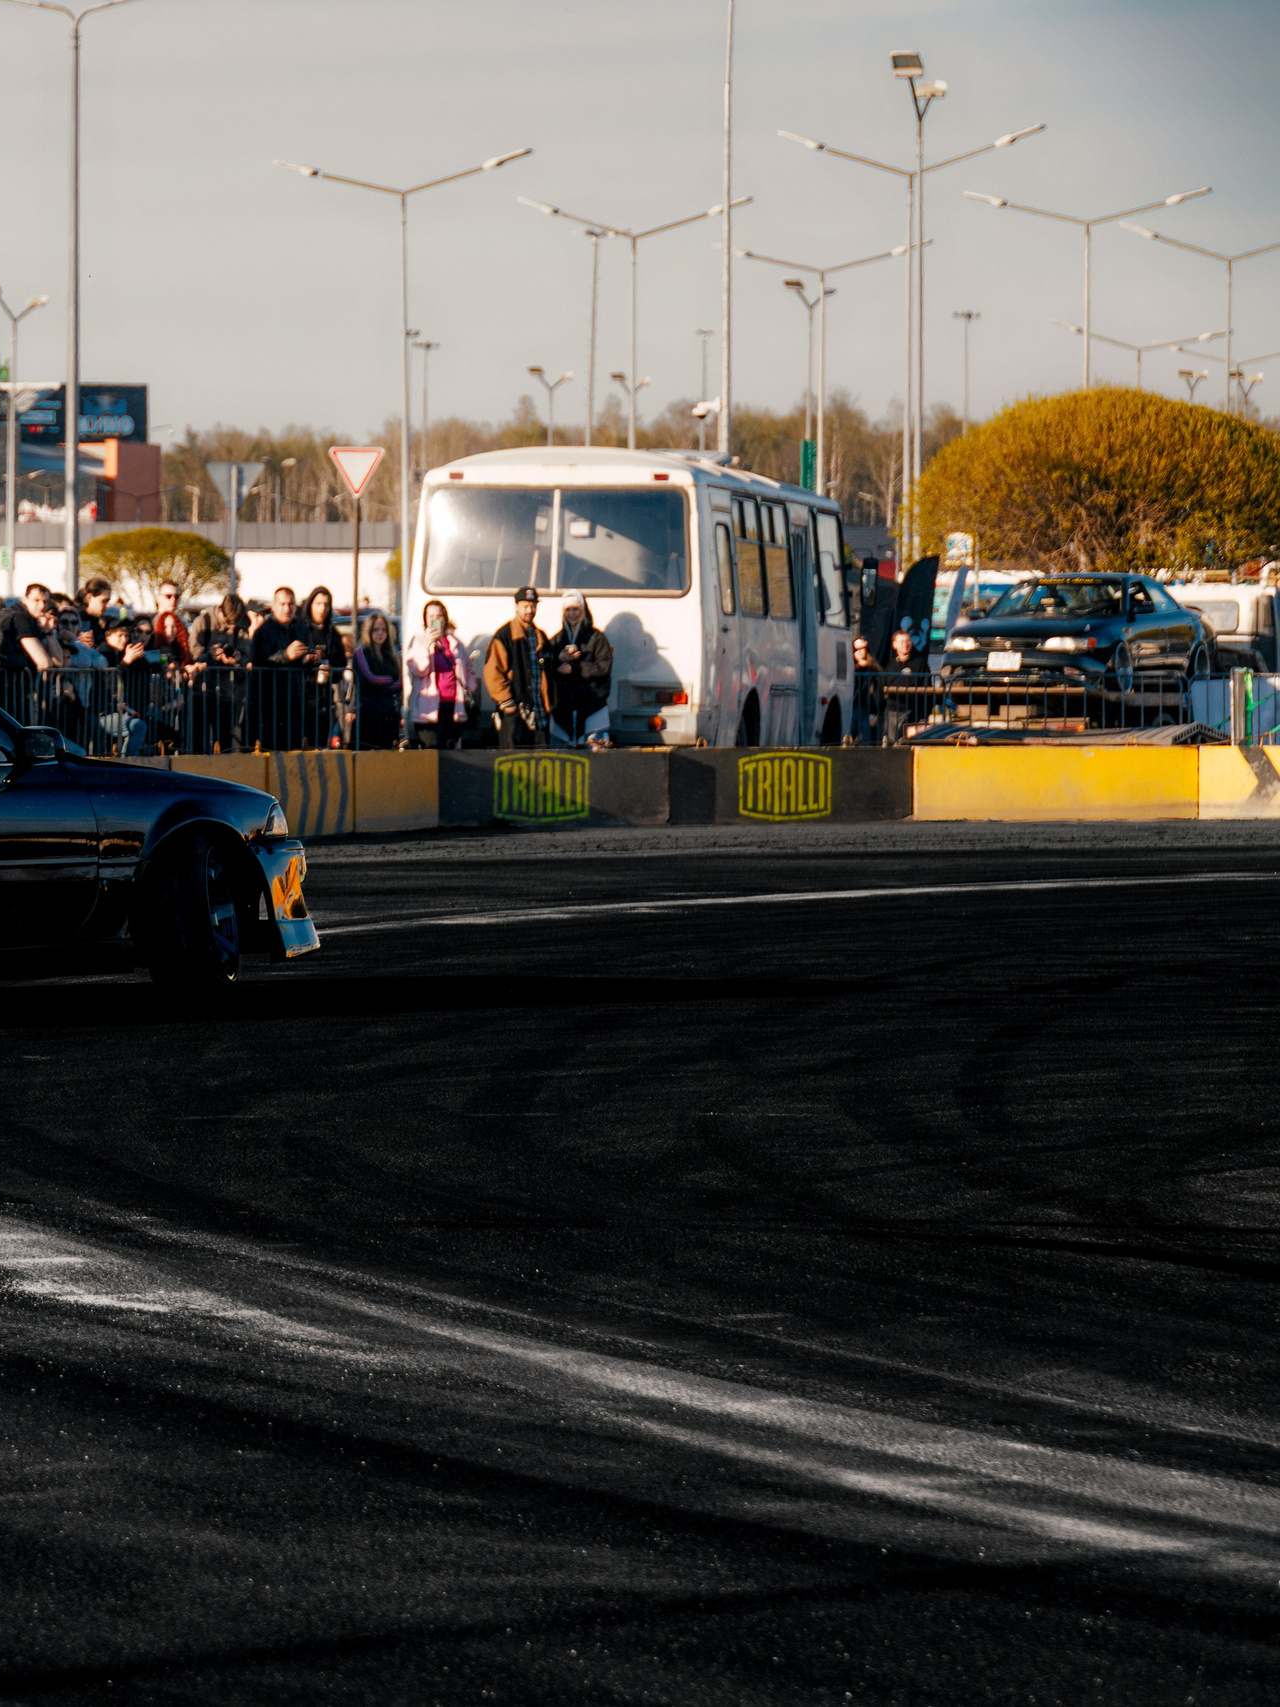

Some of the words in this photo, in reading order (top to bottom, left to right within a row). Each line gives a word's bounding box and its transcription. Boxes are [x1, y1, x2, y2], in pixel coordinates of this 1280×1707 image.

[77, 414, 135, 436] КИНО
[499, 758, 583, 815] TRIALLI
[744, 757, 825, 814] TRIALLI
